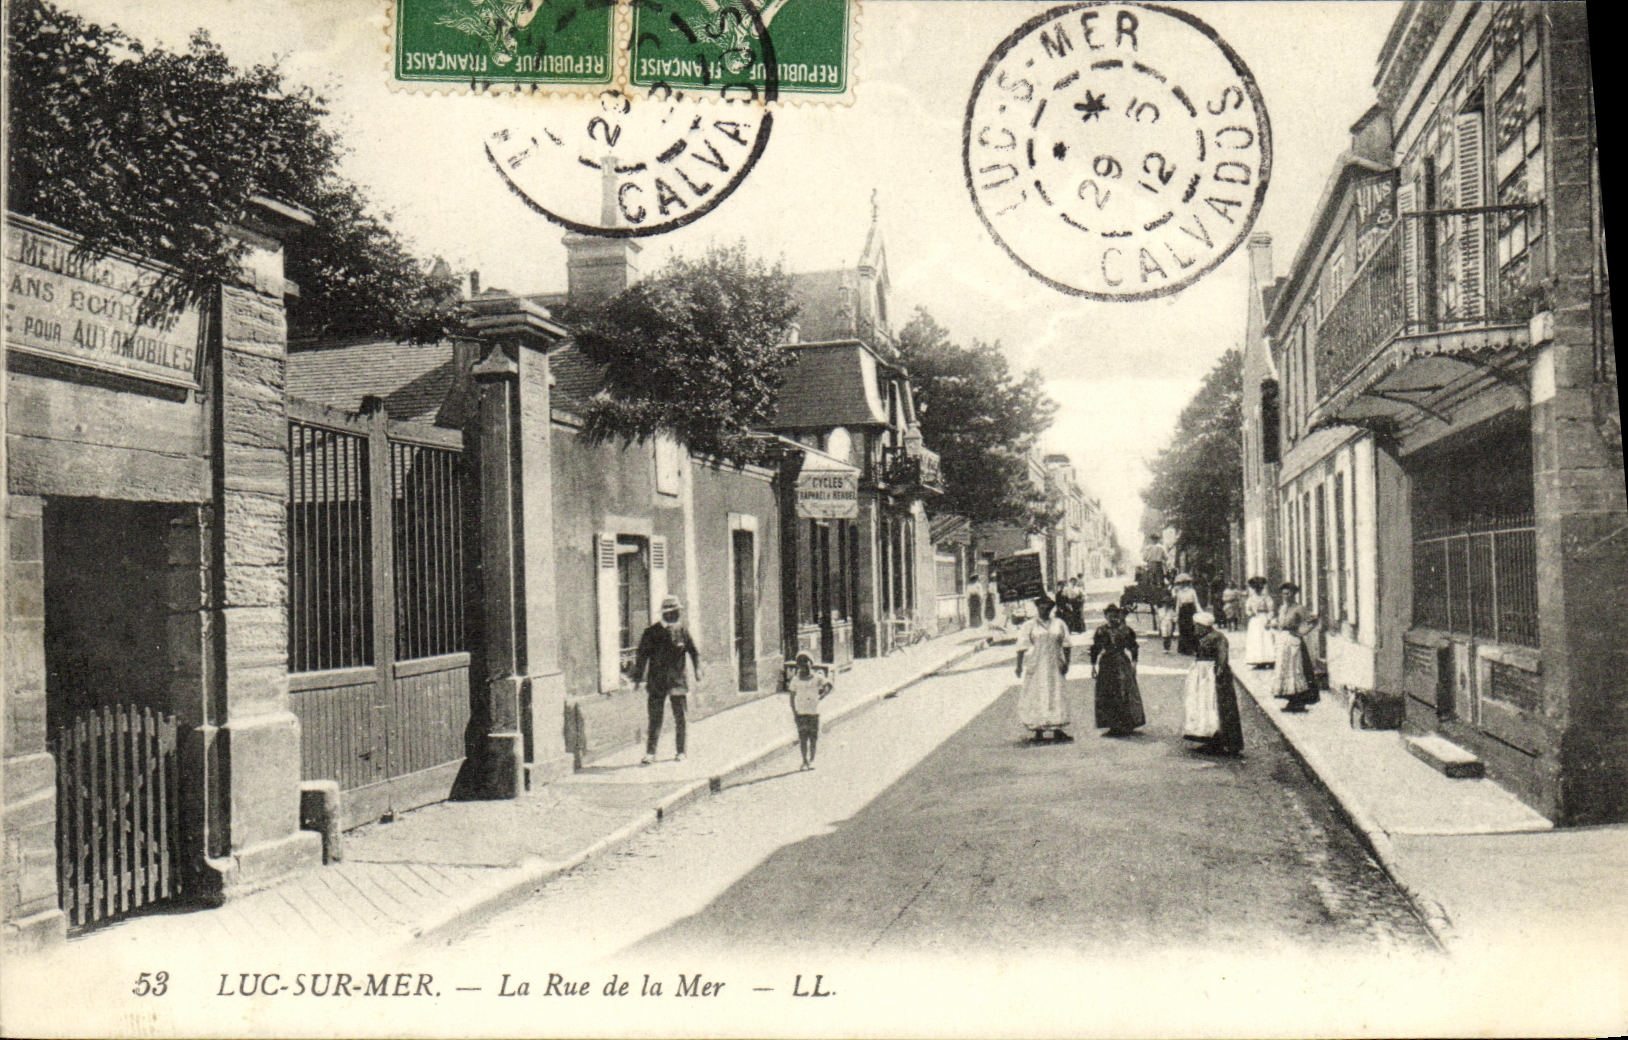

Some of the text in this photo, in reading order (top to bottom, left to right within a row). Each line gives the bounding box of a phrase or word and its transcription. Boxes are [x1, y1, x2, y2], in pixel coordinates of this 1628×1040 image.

[405, 50, 488, 71] FRANÇAISE
[750, 62, 838, 84] REPUBLIUE
[1077, 153, 1123, 210] 29
[1100, 85, 1255, 287] CALVADOS
[1138, 152, 1177, 194] 12
[24, 315, 62, 343] POUR
[73, 319, 194, 372] AUTOMOBILES
[812, 476, 844, 489] CYCLES
